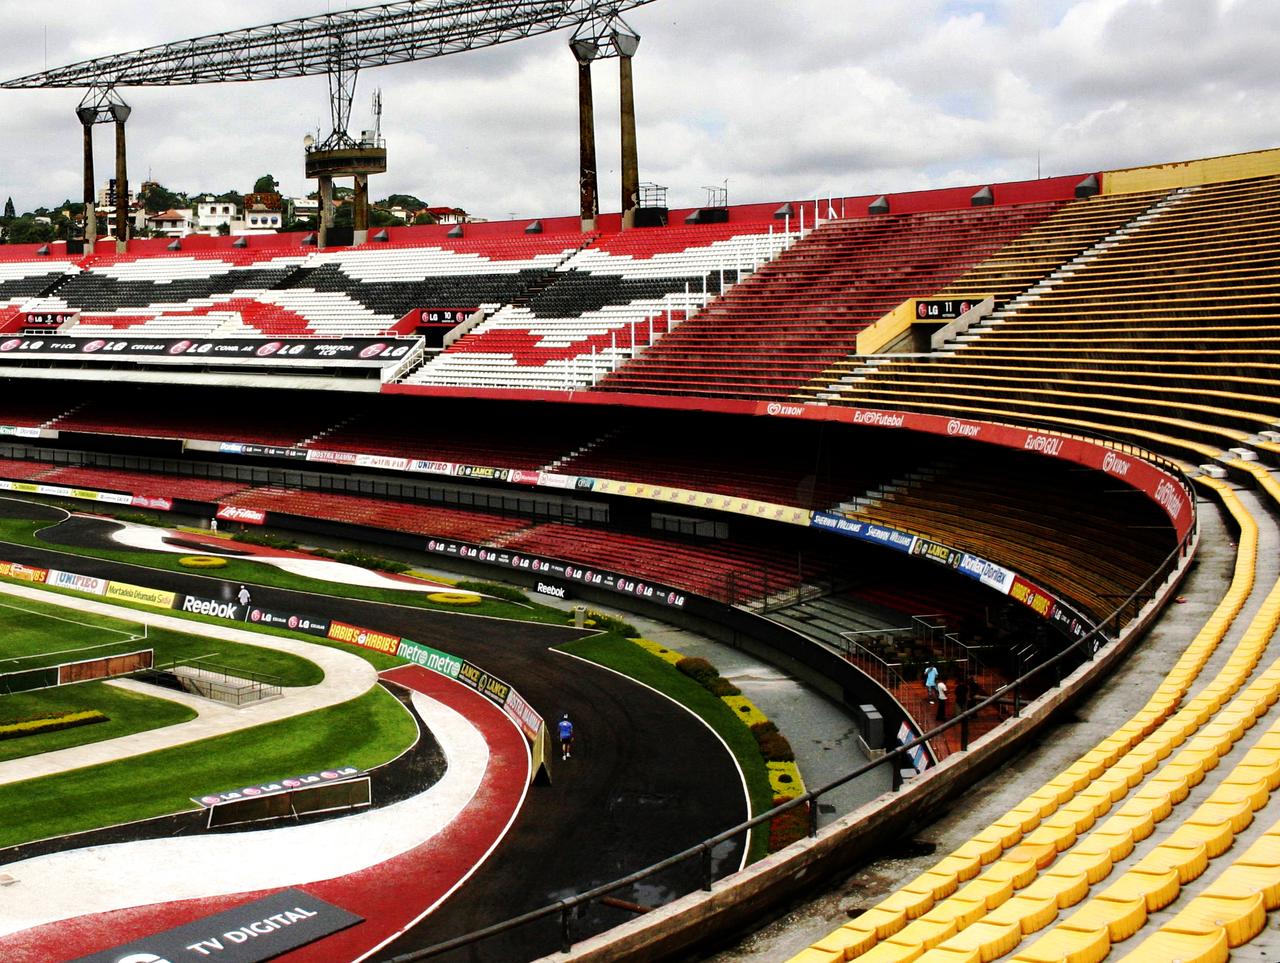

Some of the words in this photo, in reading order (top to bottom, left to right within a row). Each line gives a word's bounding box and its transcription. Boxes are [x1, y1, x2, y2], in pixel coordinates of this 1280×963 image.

[430, 313, 438, 321] LG
[444, 311, 452, 319] 10
[928, 305, 939, 315] LG
[944, 302, 953, 312] 11
[19, 341, 44, 350] LG
[103, 341, 128, 350] LG
[187, 343, 213, 352] LG
[277, 344, 305, 354] LG
[379, 345, 409, 356] LG
[780, 406, 804, 416] KIBON
[853, 410, 864, 422] Eu
[874, 413, 904, 427] Futebol
[958, 424, 980, 436] KIBON
[1024, 435, 1035, 448] Eu
[814, 515, 837, 528] SHERWIN
[866, 525, 890, 541] SHERWIN
[435, 542, 445, 551] LG
[467, 548, 477, 557] LG
[487, 552, 496, 561] LG
[519, 558, 529, 568] LG
[540, 561, 550, 571] LG
[572, 568, 582, 579] LG
[592, 573, 602, 584] LG
[625, 581, 634, 592] LG
[644, 586, 653, 597] LG
[674, 594, 684, 606] LG
[537, 582, 565, 598] Reebok
[183, 595, 237, 619] Reebok
[261, 613, 272, 622] LG
[298, 619, 310, 629] LG
[329, 623, 358, 643] HABIB'S
[365, 632, 398, 653] HABIB'S
[397, 642, 428, 664] metro
[427, 654, 461, 677] metro
[461, 661, 481, 682] LANCE
[487, 675, 508, 698] LANCE
[186, 937, 225, 955] TV
[223, 906, 318, 943] DIGITAL
